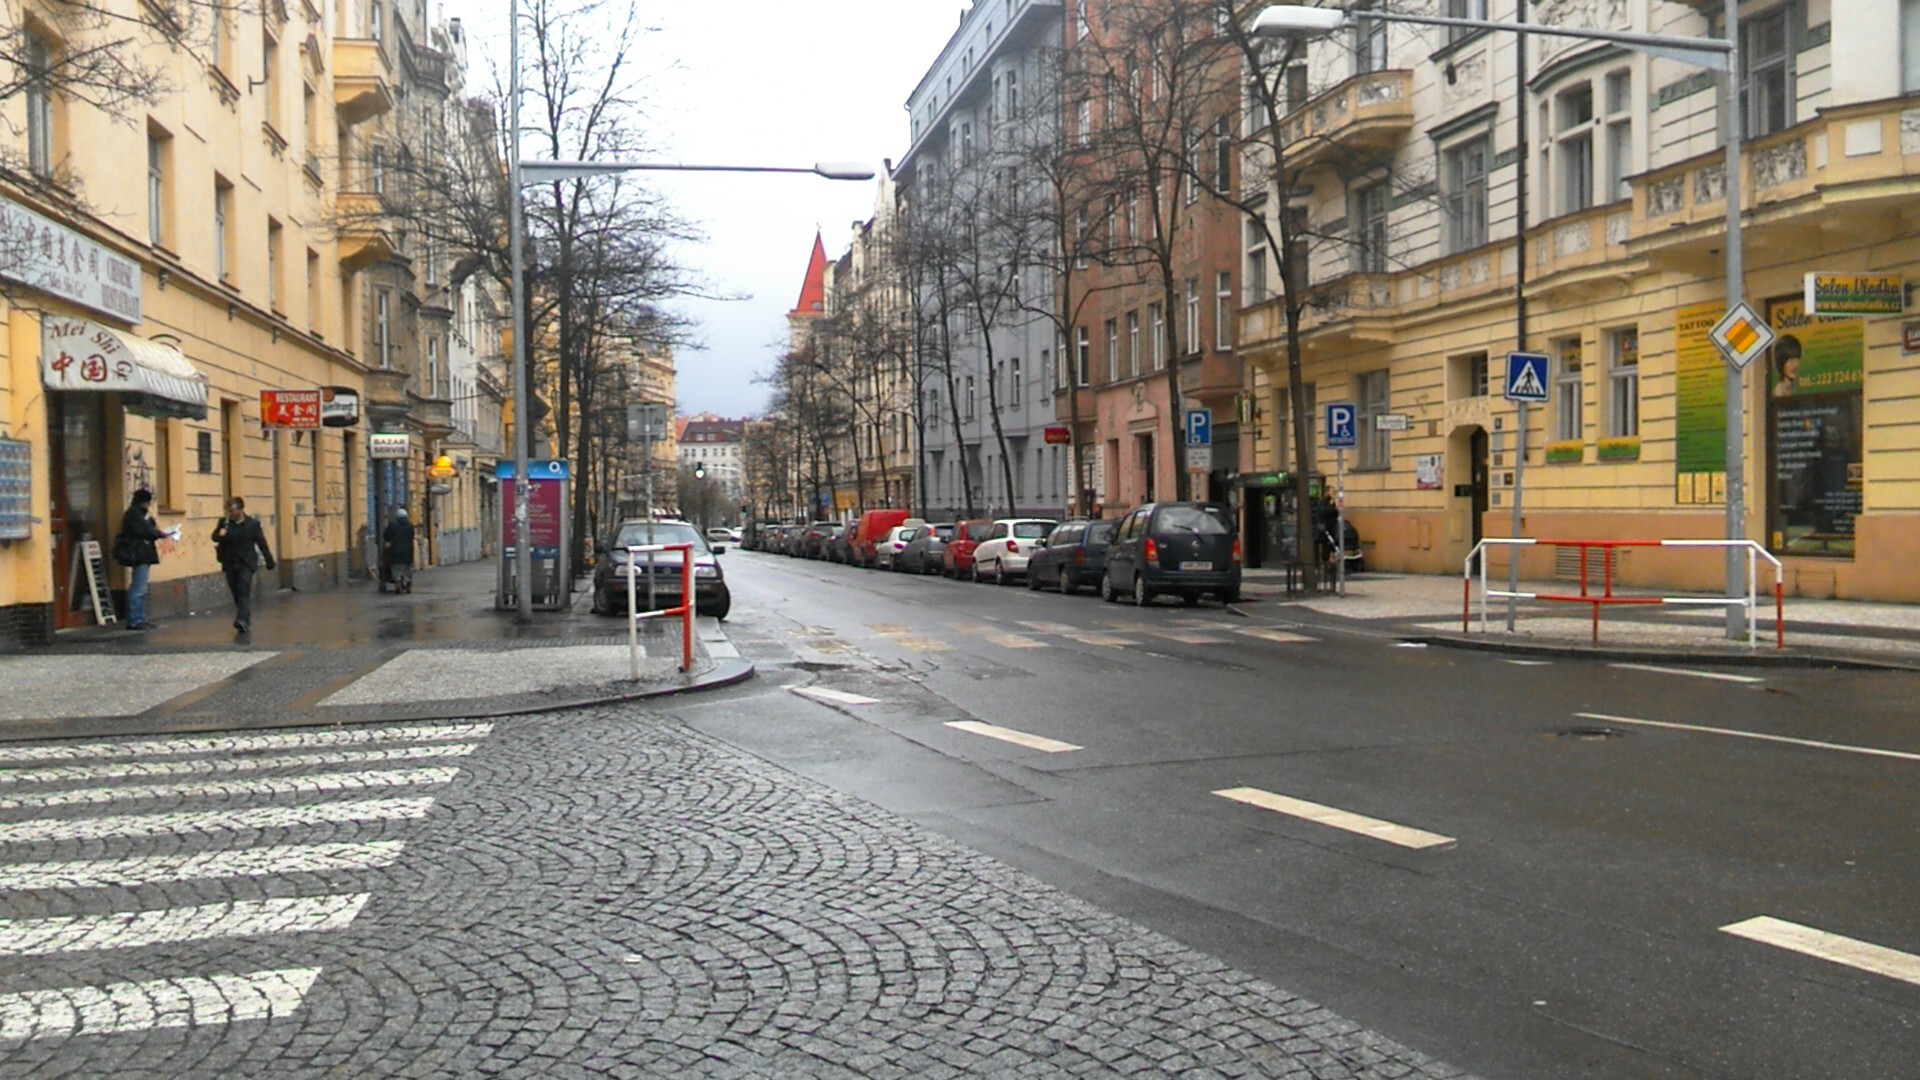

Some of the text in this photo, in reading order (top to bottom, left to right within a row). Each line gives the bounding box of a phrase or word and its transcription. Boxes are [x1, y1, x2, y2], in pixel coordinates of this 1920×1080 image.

[1815, 277, 1851, 295] Salon
[1679, 319, 1715, 332] TATTOO
[51, 321, 87, 339] Mei
[90, 332, 121, 355] Shi
[1191, 413, 1206, 434] P
[1332, 408, 1351, 435] P
